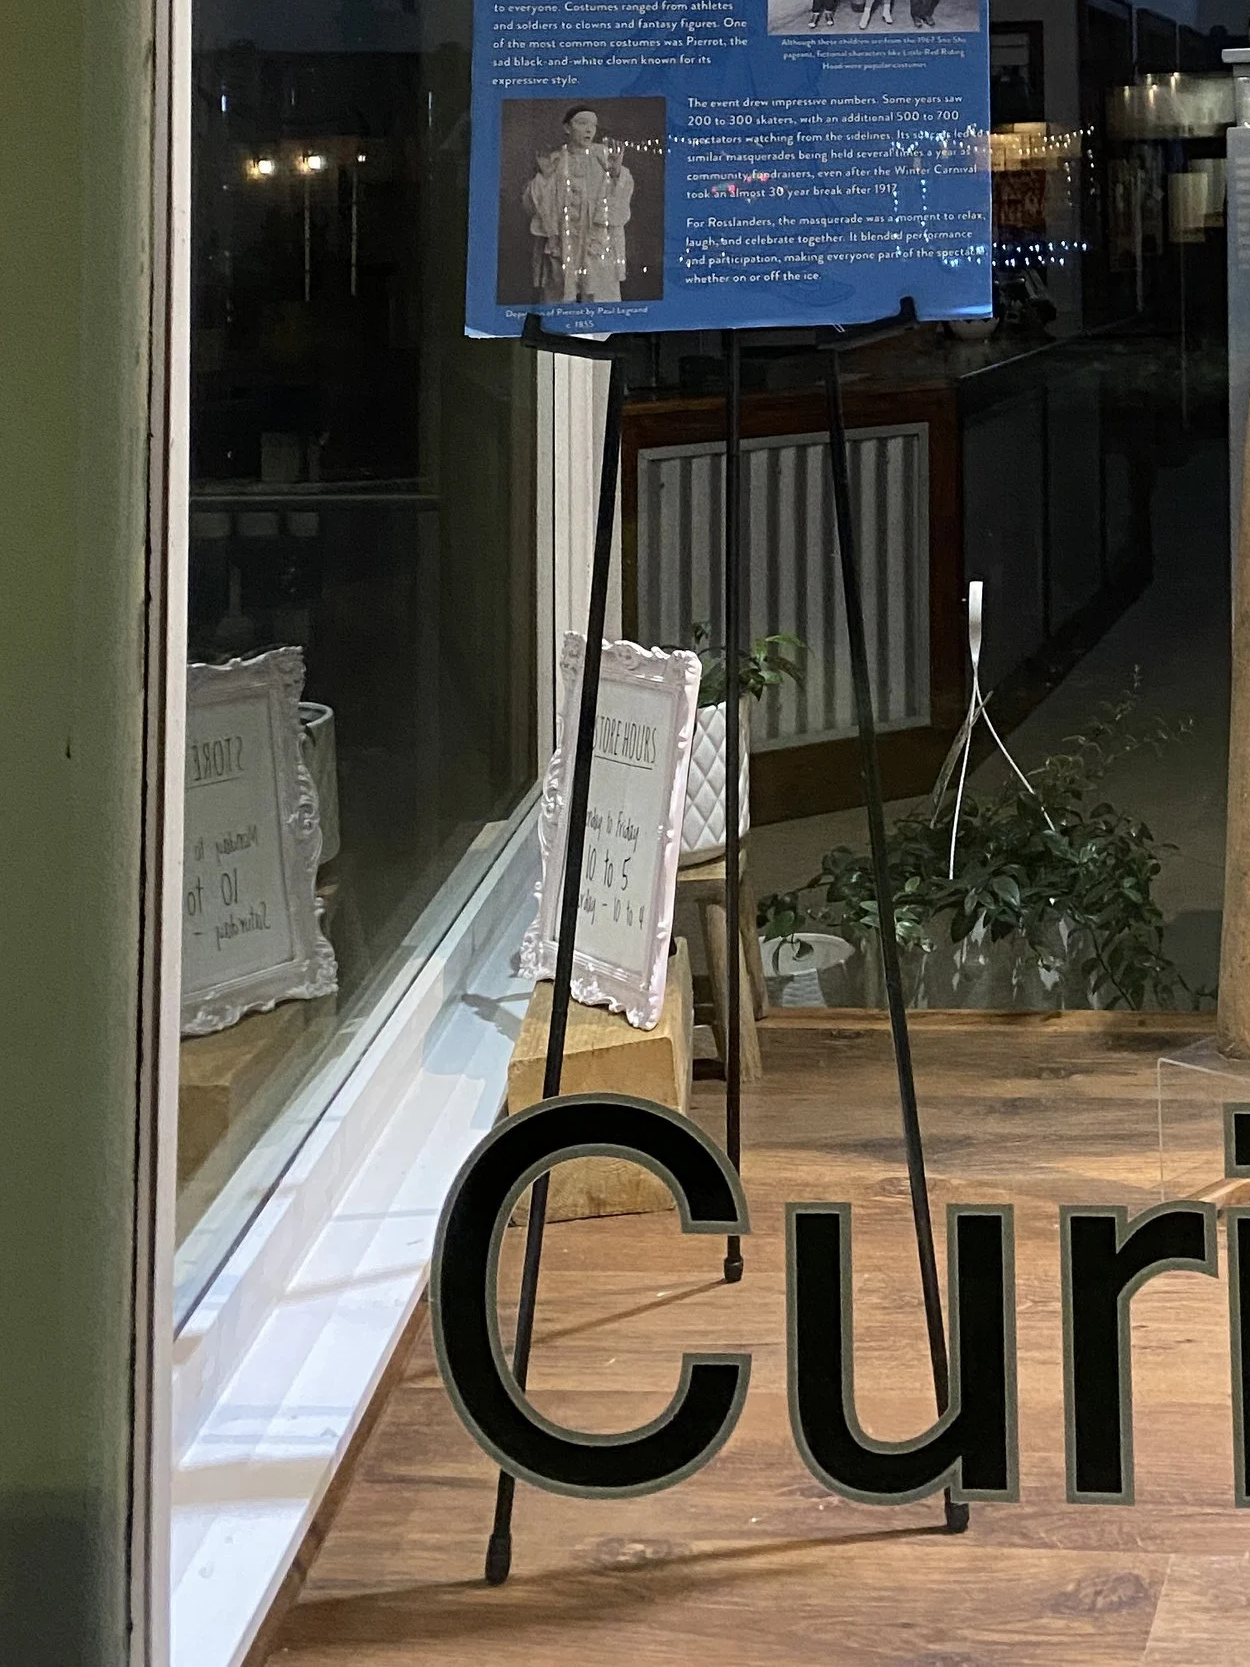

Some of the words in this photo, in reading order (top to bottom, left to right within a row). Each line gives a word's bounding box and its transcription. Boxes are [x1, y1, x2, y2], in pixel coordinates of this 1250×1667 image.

[687, 97, 707, 107] The
[710, 99, 740, 107] event
[742, 96, 768, 106] drew
[771, 98, 827, 109] impressive
[881, 93, 911, 103] Some
[911, 96, 941, 107] years
[687, 115, 711, 126] 200
[714, 117, 725, 125] to
[727, 114, 752, 125] 300
[799, 113, 823, 123] with
[841, 111, 893, 122] additional
[894, 110, 919, 121] 500
[922, 113, 933, 121] to
[936, 109, 959, 120] 700
[684, 272, 729, 283] whether
[749, 274, 761, 282] or
[763, 269, 781, 281] off
[782, 270, 800, 281] the
[622, 722, 657, 764] HOURS
[616, 811, 640, 853] Friday
[585, 844, 597, 881] 10
[604, 849, 614, 888] to
[621, 857, 632, 891] 5
